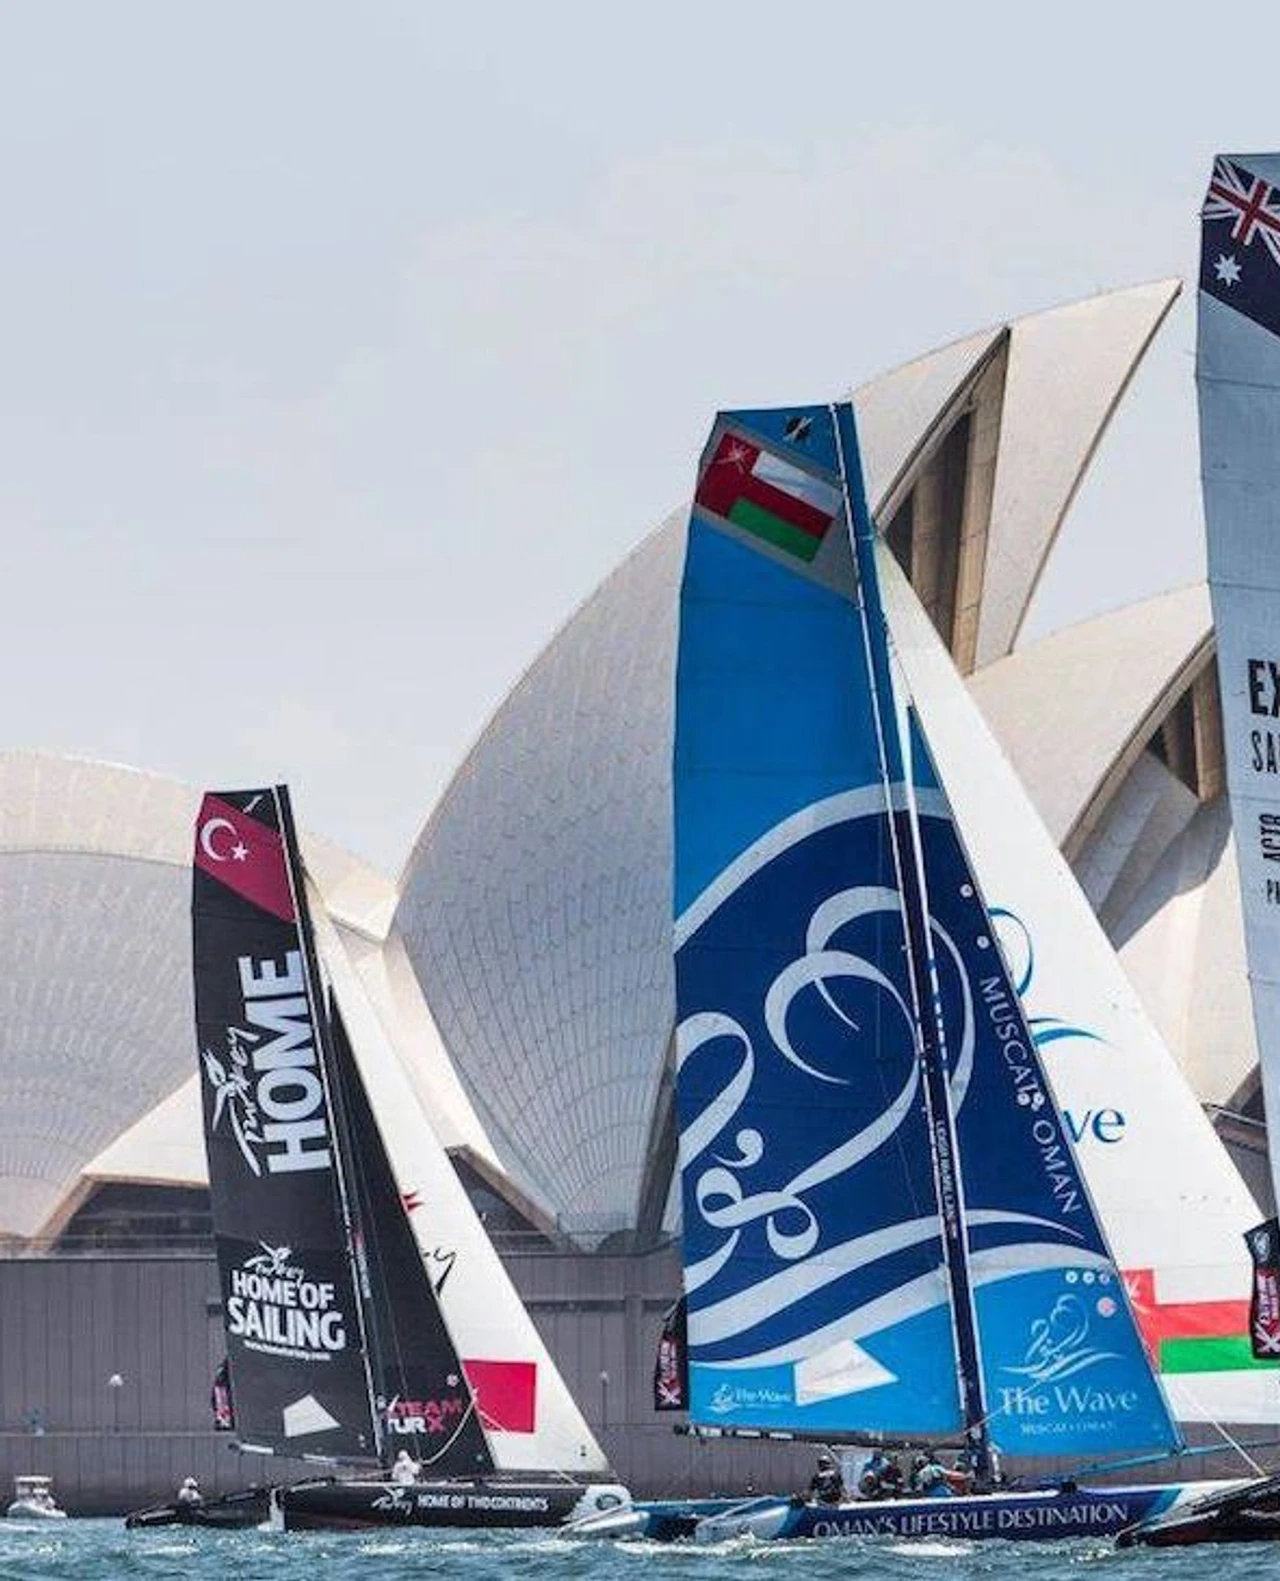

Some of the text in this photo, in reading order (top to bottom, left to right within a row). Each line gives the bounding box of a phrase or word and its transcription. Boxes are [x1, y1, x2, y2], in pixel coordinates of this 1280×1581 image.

[238, 949, 333, 1175] HOME
[979, 975, 1083, 1216] MUSCAT OMAN
[231, 1269, 335, 1310] HOME OF
[227, 1297, 347, 1351] SAILING
[1000, 1386, 1139, 1416] The Wave
[812, 1501, 1129, 1538] OMAN'S LIFESTYLE DESTINATION
